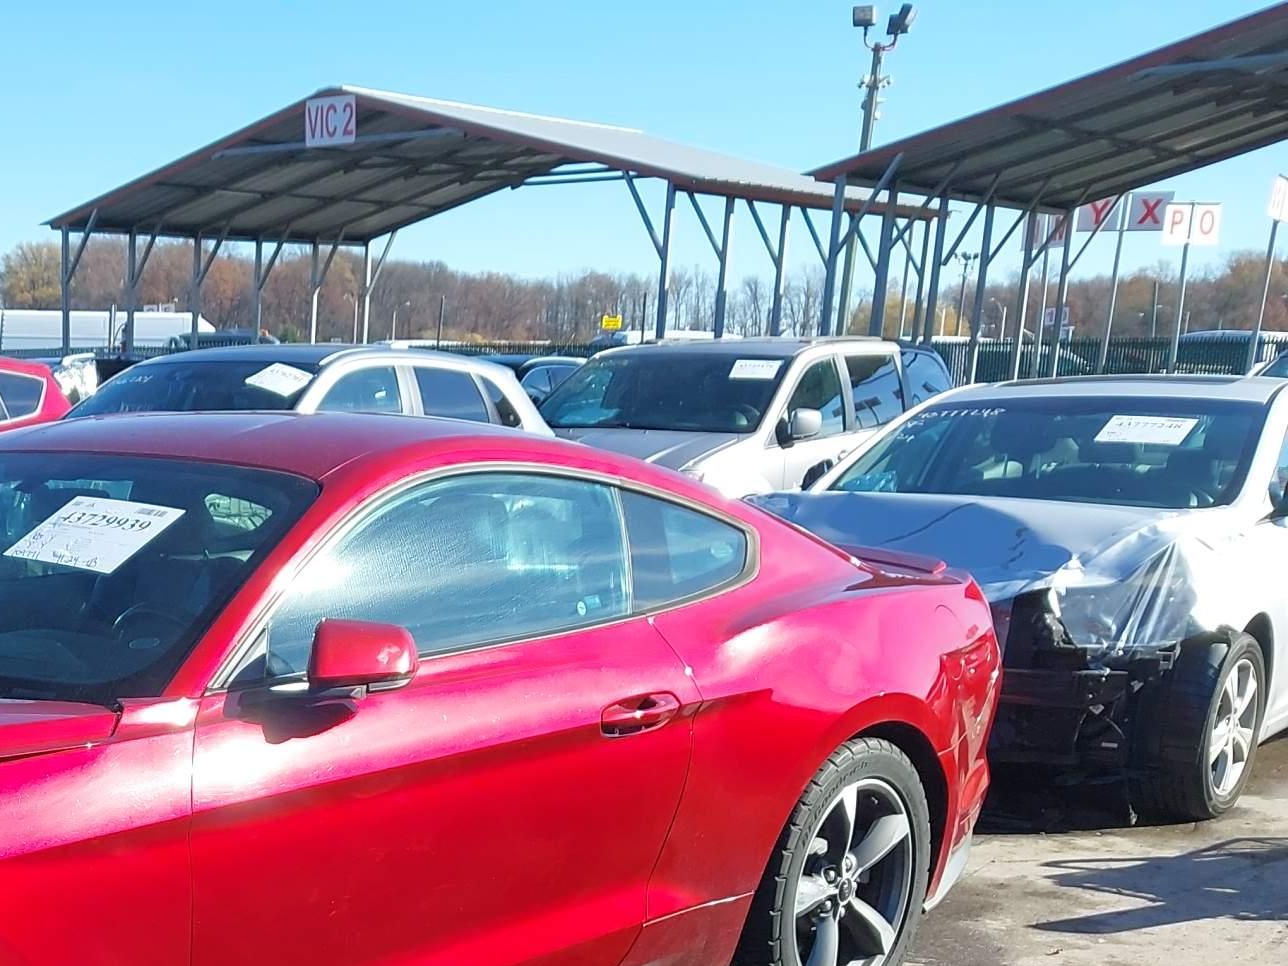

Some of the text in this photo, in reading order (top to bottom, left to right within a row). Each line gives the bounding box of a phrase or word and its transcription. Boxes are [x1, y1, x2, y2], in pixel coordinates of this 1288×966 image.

[307, 101, 354, 139] VIC 2
[1090, 198, 1163, 225] Y X
[1170, 209, 1184, 235] P
[61, 511, 152, 531] 43729939
